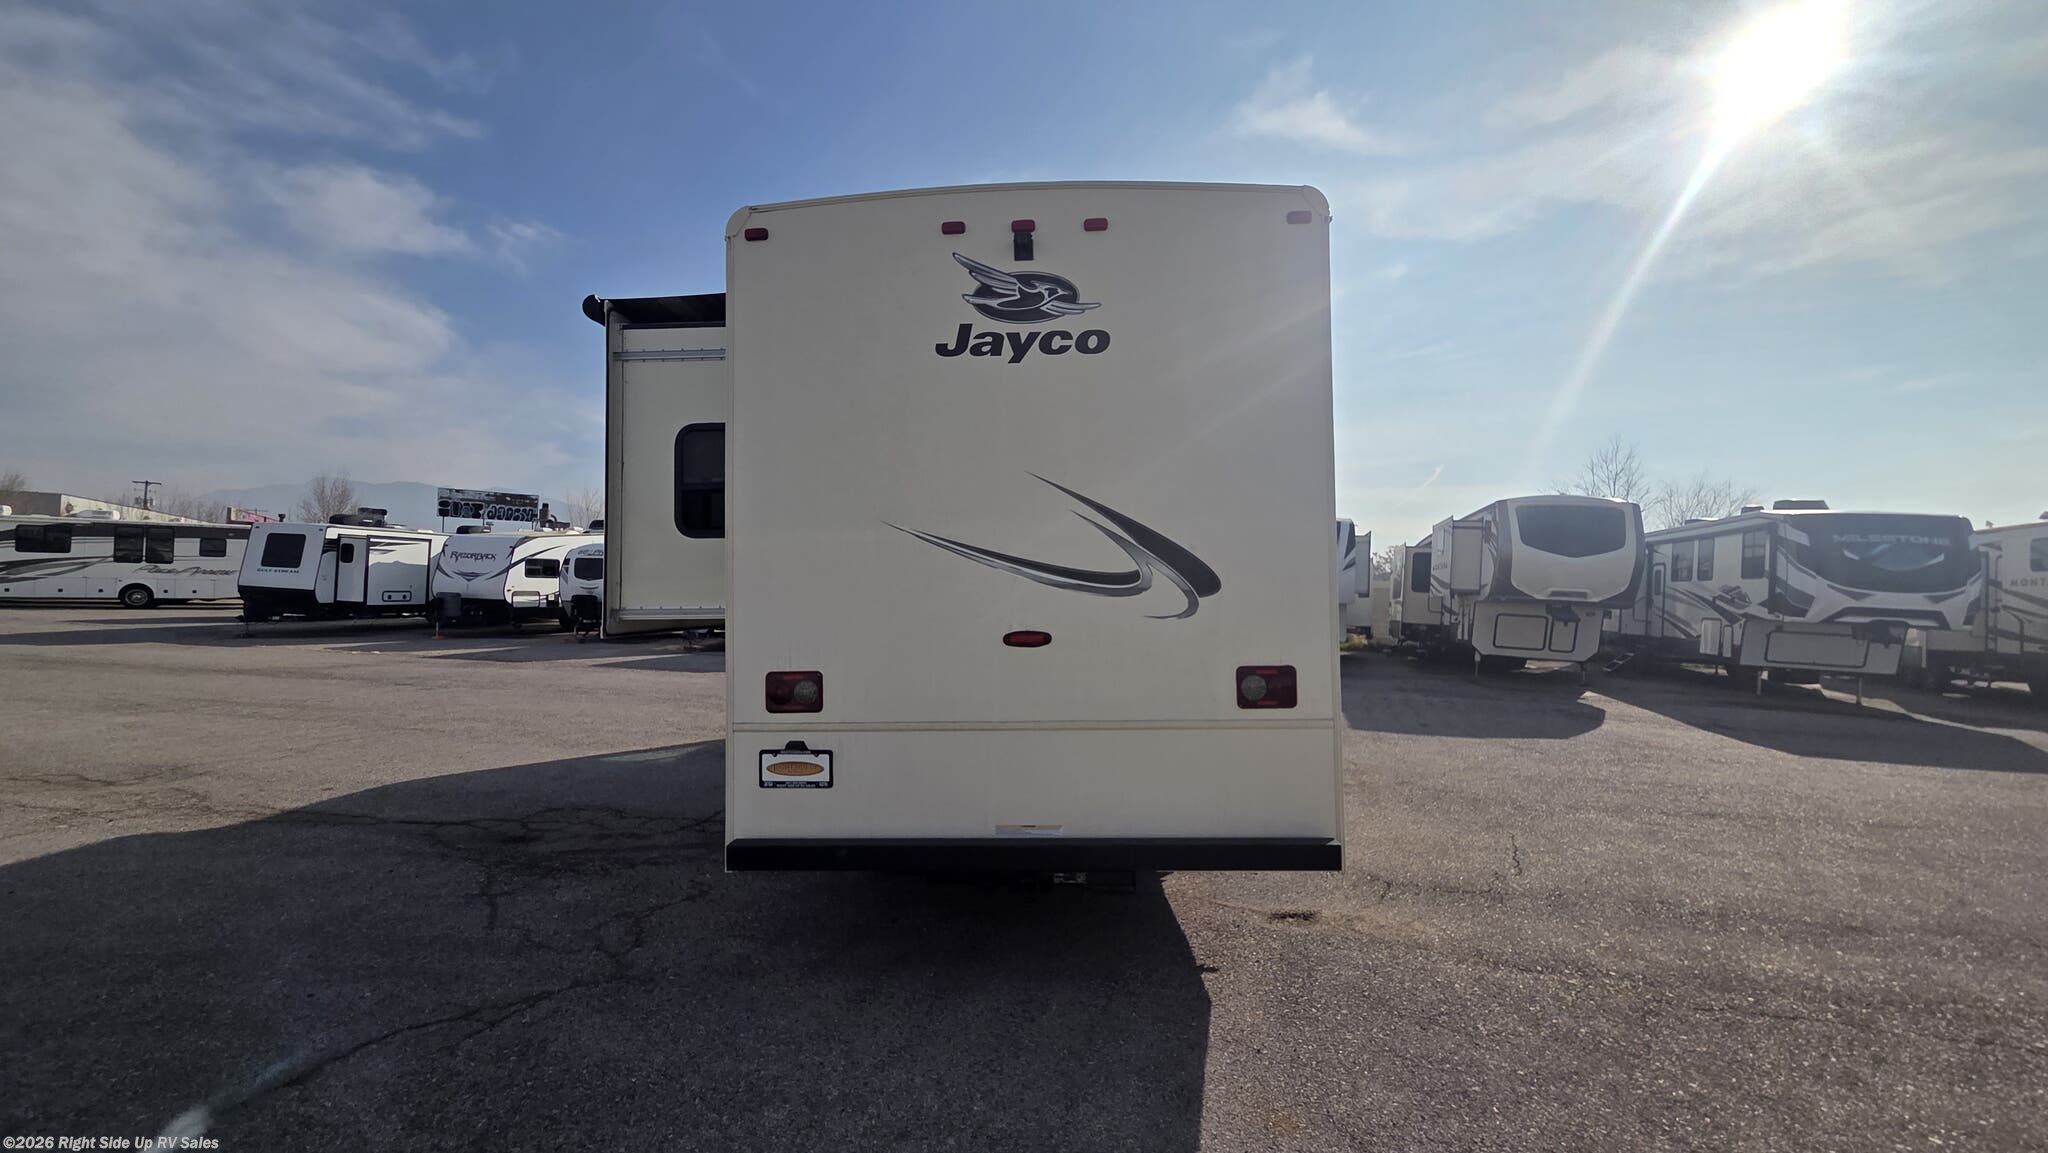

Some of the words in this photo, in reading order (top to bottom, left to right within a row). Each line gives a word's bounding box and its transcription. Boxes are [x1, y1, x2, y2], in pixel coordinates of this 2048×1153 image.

[935, 323, 1111, 363] Jayco
[1831, 534, 1952, 545] MILESTONE
[2010, 577, 2048, 587] MONT
